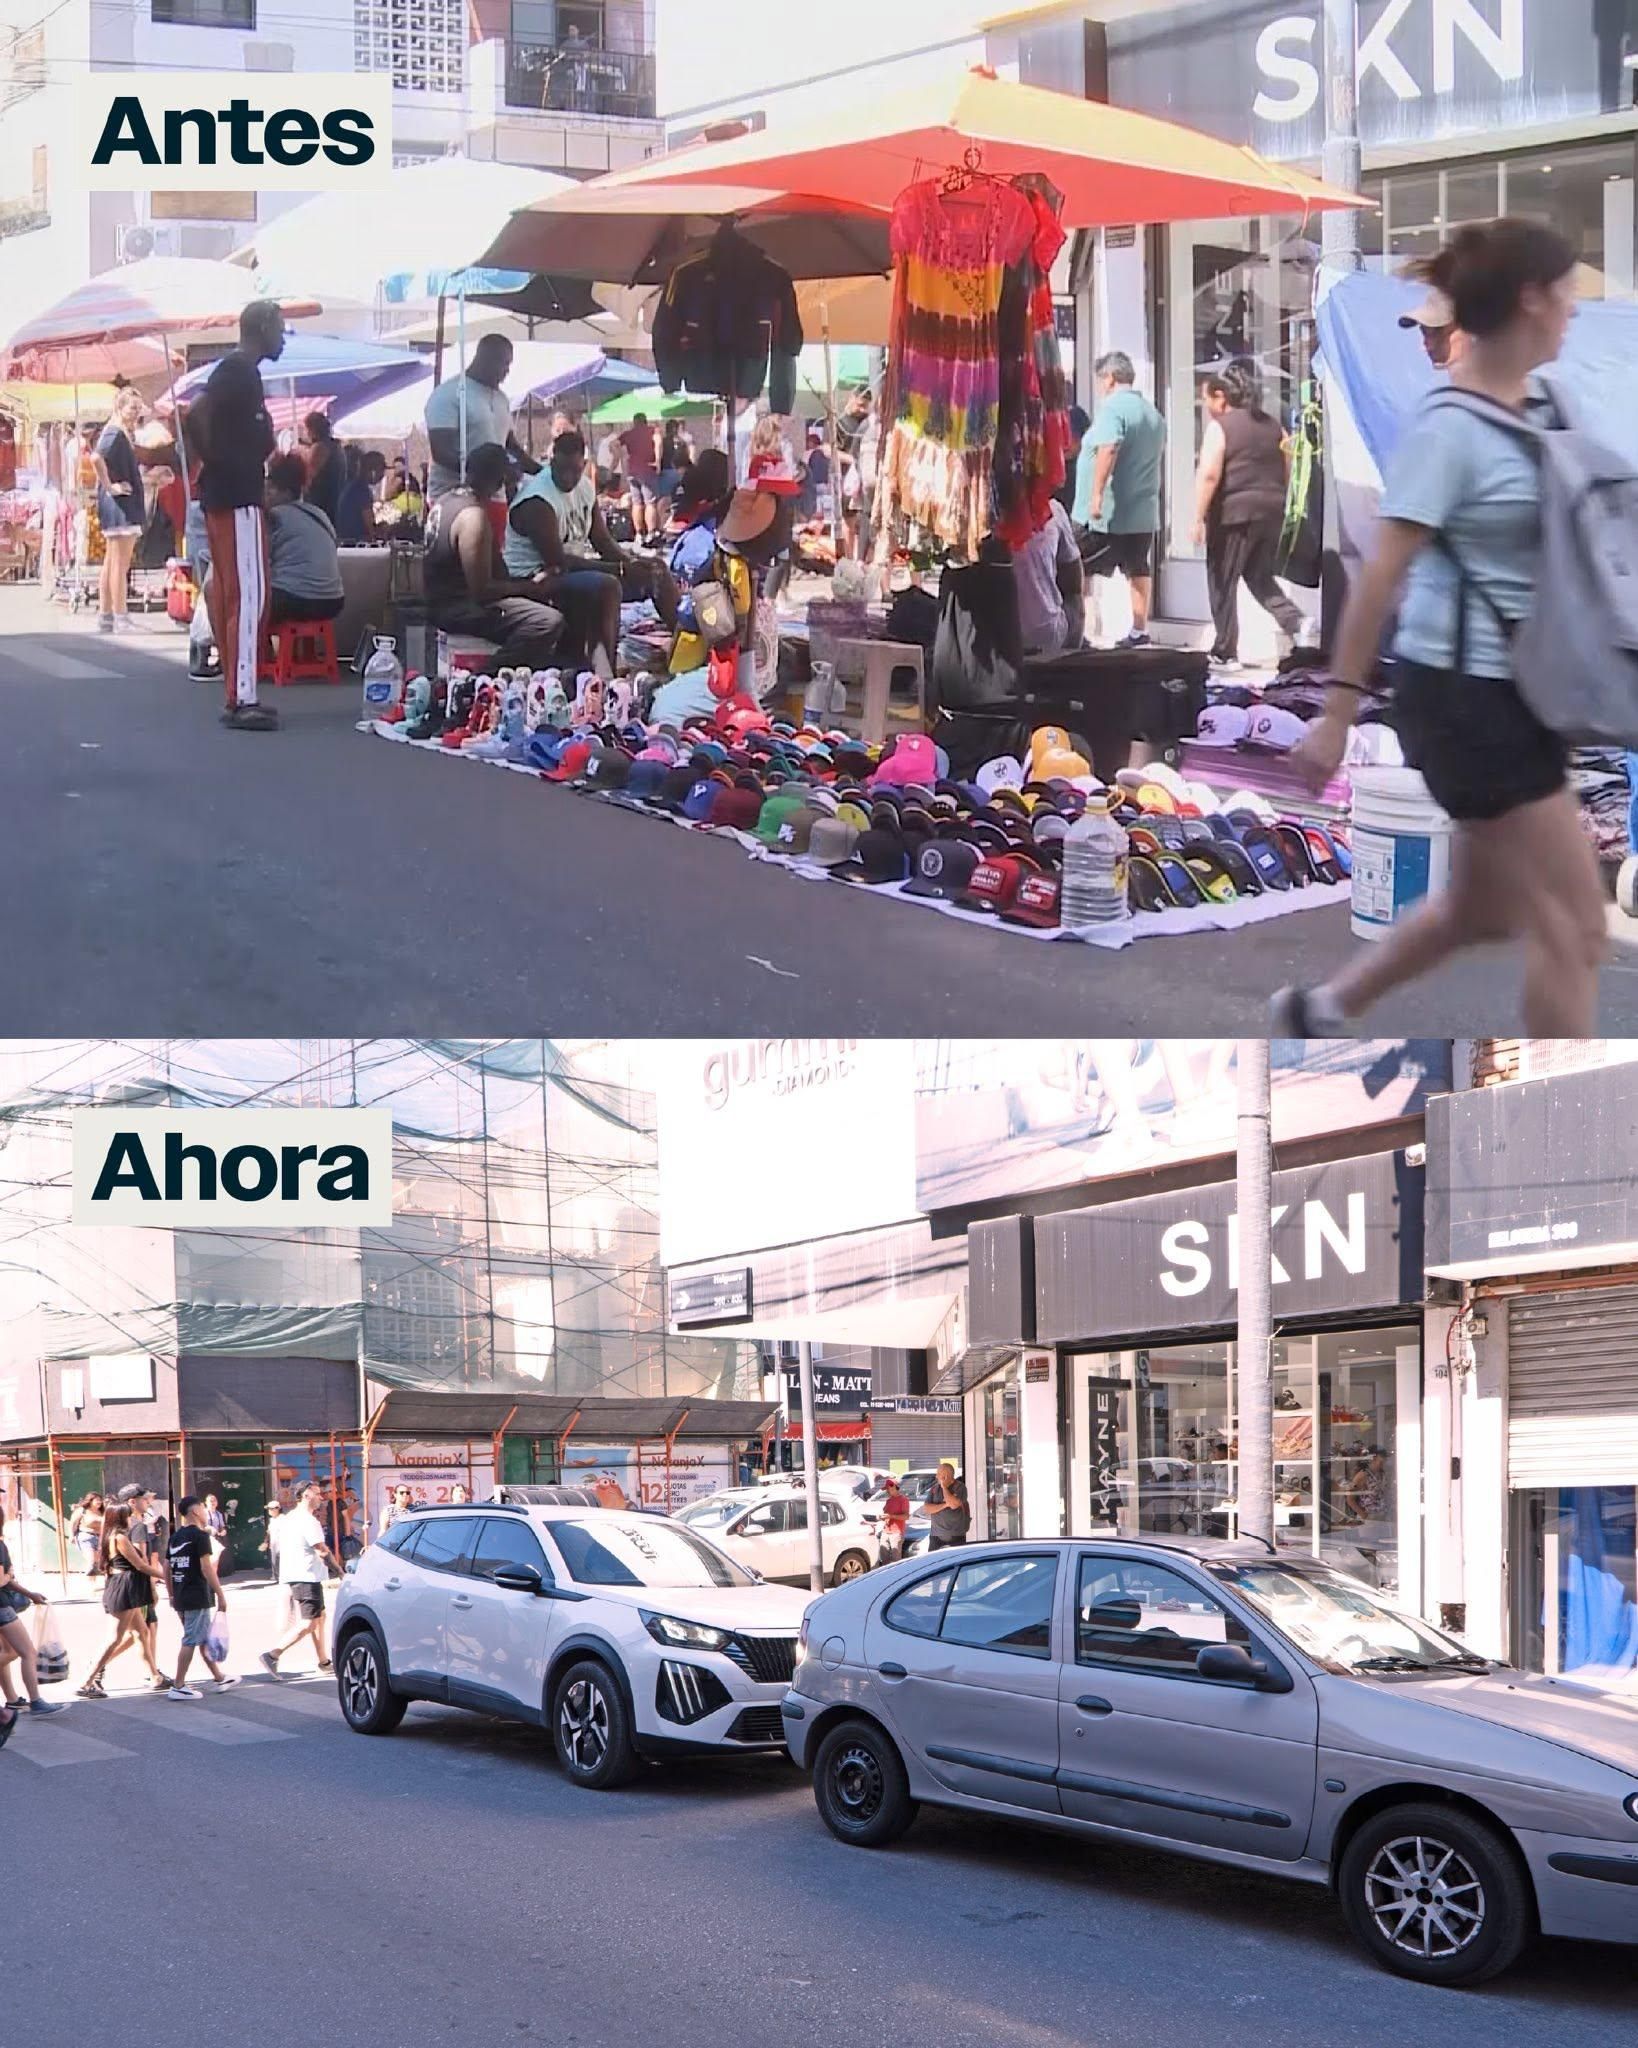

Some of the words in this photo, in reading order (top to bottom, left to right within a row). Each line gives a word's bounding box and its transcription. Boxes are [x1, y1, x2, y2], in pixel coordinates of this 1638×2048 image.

[1253, 0, 1523, 122] SKN
[1159, 1192, 1366, 1297] SKN
[641, 1483, 662, 1503] 12
[1097, 1393, 1110, 1514] KAYNE
